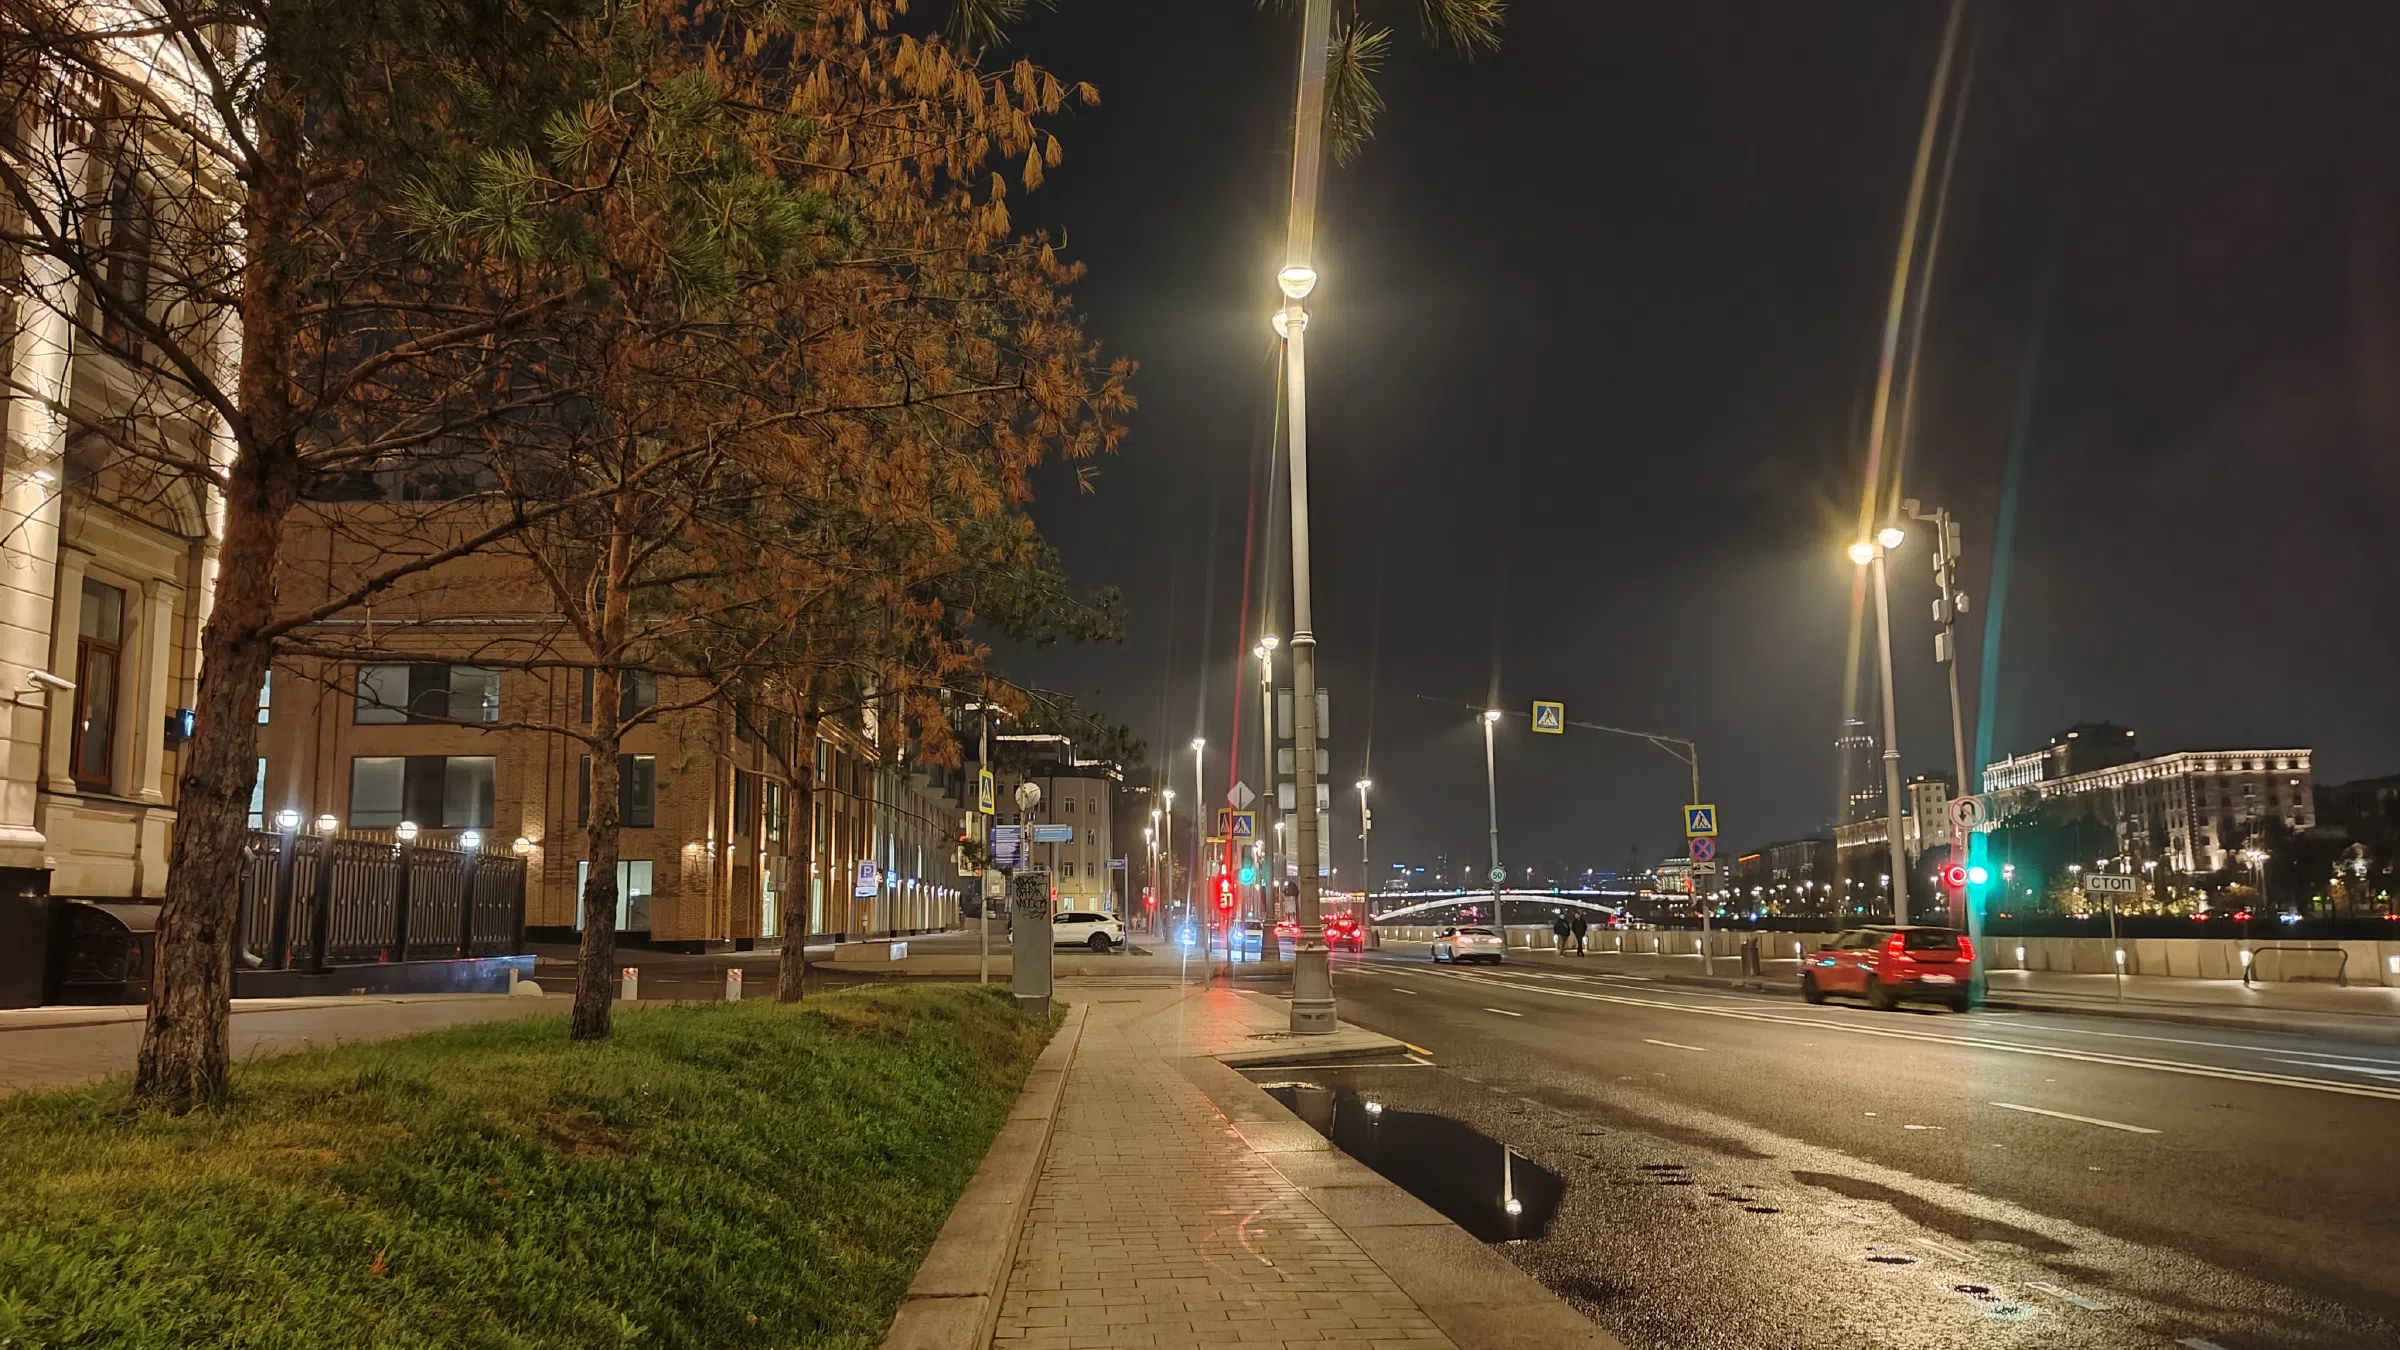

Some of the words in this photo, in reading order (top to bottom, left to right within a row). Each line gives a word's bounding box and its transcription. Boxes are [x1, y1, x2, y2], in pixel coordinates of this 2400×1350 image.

[1492, 871, 1503, 880] 50
[2091, 877, 2131, 890] СТОП
[1220, 893, 1233, 908] 37
